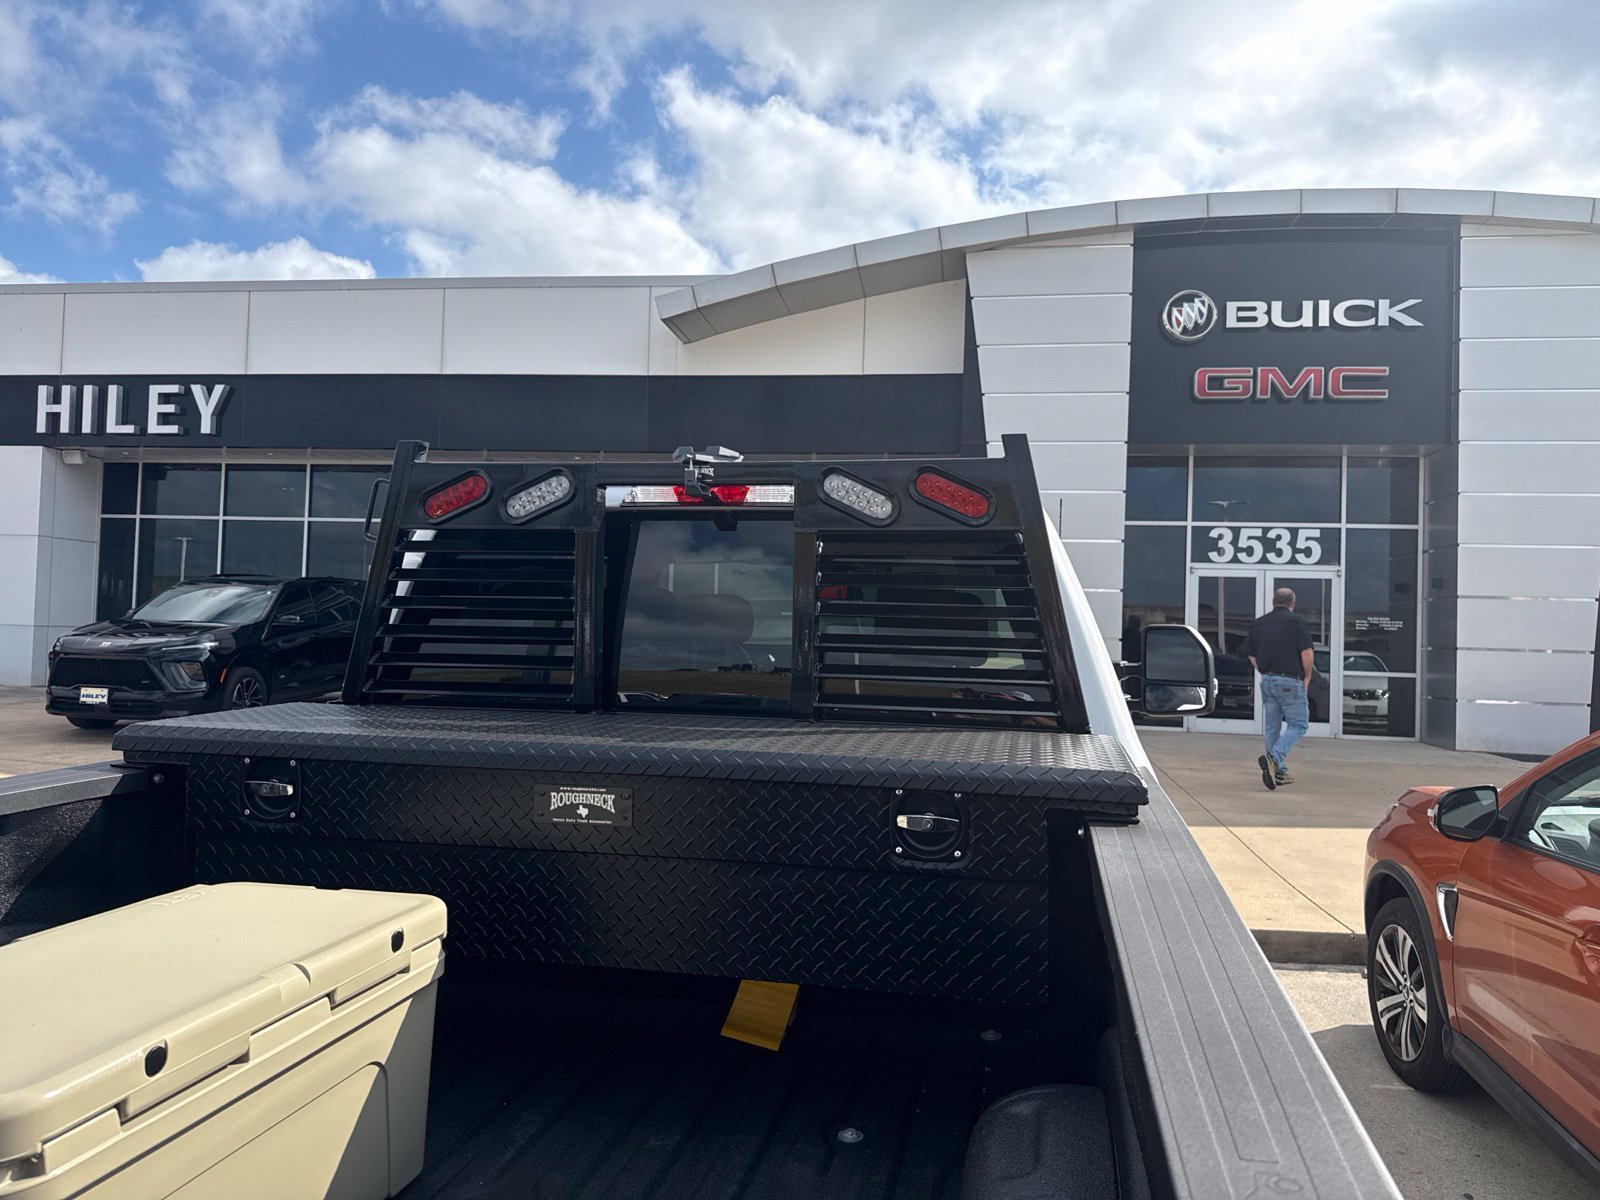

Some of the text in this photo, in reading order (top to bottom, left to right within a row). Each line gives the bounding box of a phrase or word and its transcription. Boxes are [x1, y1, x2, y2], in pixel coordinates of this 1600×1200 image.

[1226, 298, 1423, 329] BUICK
[1193, 366, 1389, 399] GMC
[36, 384, 230, 434] HILEY
[1207, 527, 1322, 564] 3535
[550, 792, 616, 814] ROUGHNECK
